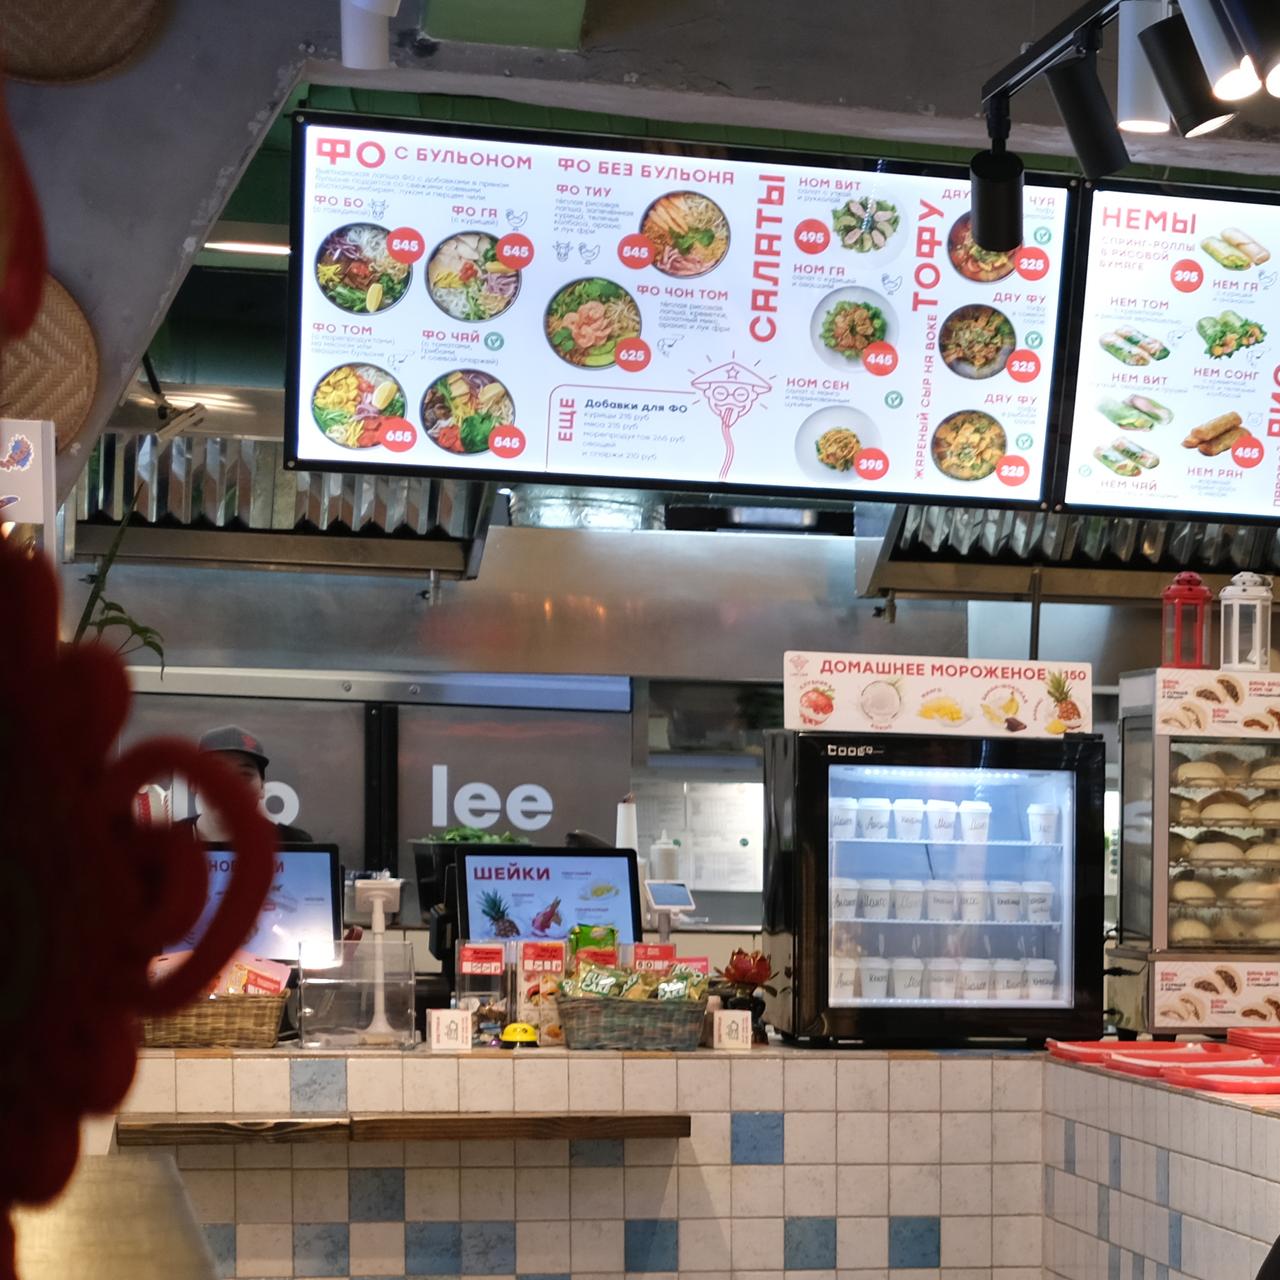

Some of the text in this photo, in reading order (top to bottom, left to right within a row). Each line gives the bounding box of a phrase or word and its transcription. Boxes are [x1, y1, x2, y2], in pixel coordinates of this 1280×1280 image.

[316, 137, 533, 170] ФО С БУЛЬОНОМ
[558, 157, 735, 186] ФО БЕЗ БУЛЬОНА
[556, 183, 612, 198] ФО ТИУ
[799, 177, 862, 192] НОМ ВИТ
[314, 194, 364, 209] ФО БО
[451, 204, 498, 219] ФО ГА
[1101, 206, 1197, 235] НЕМЫ
[798, 231, 825, 243] 495
[1102, 236, 1196, 252] СПРИНГ-РОЛЛЫ
[391, 239, 419, 252] 545
[502, 245, 529, 258] 545
[622, 246, 649, 259] 545
[748, 174, 786, 343] САЛАТЫ
[912, 199, 945, 313] ТОФУ
[1110, 248, 1170, 262] РИСОВОЙ
[793, 263, 846, 277] НОМ ГА
[1019, 257, 1044, 269] 325
[1099, 261, 1145, 272] БУМАГЕ
[1174, 270, 1199, 282] 395
[1212, 279, 1260, 292] НЕМ ГА
[636, 284, 729, 302] ФО ЧОН ТОМ
[992, 292, 1047, 305] ДАУ ФУ
[1110, 296, 1170, 310] НЕМ ТОМ
[312, 321, 373, 336] ФО ТОМ
[422, 329, 480, 344] ФО ЧАЙ
[619, 348, 645, 361] 625
[866, 354, 893, 366] 445
[1011, 360, 1035, 372] 325
[1112, 372, 1169, 385] НЕМ ВИТ
[1193, 367, 1260, 381] НЕМ СОНГ
[786, 377, 850, 391] НОМ СЕН
[913, 313, 938, 480] ЖАРЕНЫЙ СЫР НА ВОКЕ
[983, 393, 1038, 406] ДАУ ФУ
[585, 398, 688, 414] Добавки для ФО
[557, 397, 576, 442] ЕЩЕ
[385, 430, 412, 443] 655
[493, 436, 520, 449] 545
[859, 458, 884, 470] 395
[1001, 465, 1025, 478] 325
[1187, 466, 1244, 480] НЕМ РАН
[820, 659, 1087, 682] ДОМАШНЕЕ МОРОЖЕНОЕ 150
[431, 764, 554, 832] lee
[473, 862, 551, 881] ШЕЙКИ
